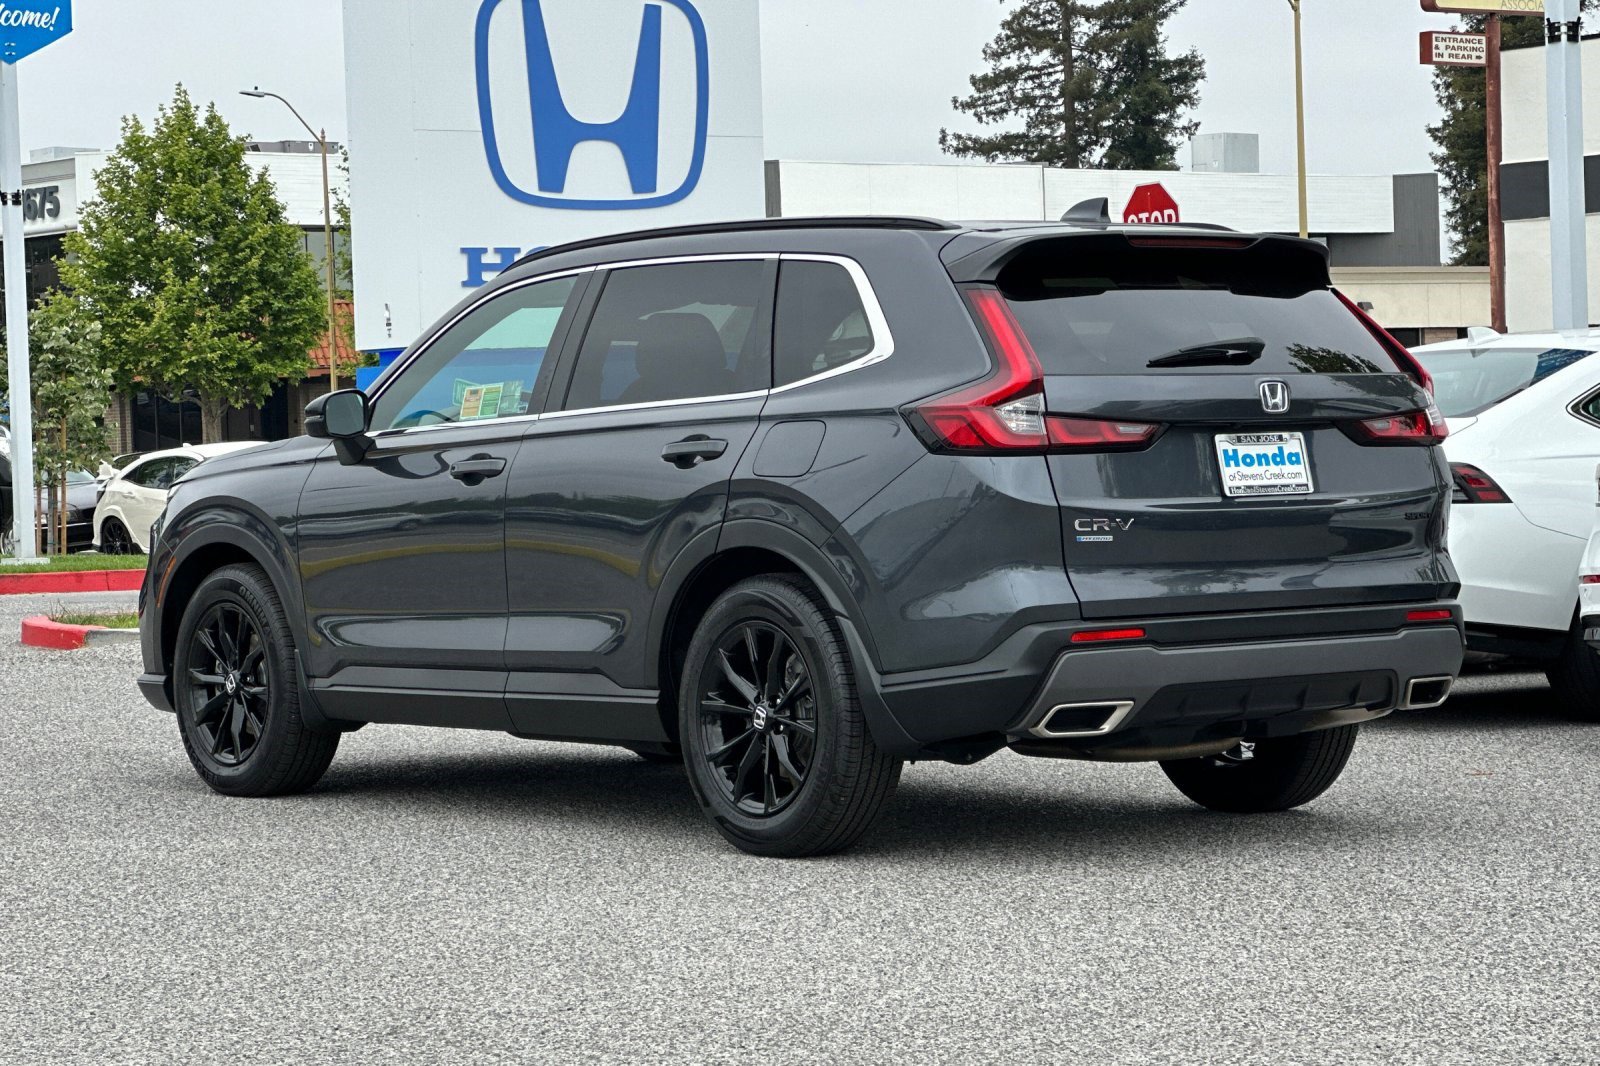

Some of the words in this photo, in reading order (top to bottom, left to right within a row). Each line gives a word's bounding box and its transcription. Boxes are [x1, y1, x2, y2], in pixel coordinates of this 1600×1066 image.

[1434, 36, 1484, 45] ENTRANCE
[1445, 45, 1485, 53] PARKING
[22, 186, 60, 222] 675
[1240, 435, 1257, 443] SAN
[1259, 435, 1280, 443] JOSE
[1222, 446, 1302, 468] Honda
[1236, 470, 1264, 481] Stevens
[1264, 468, 1303, 481] Creek.com
[1074, 518, 1134, 531] CR-V
